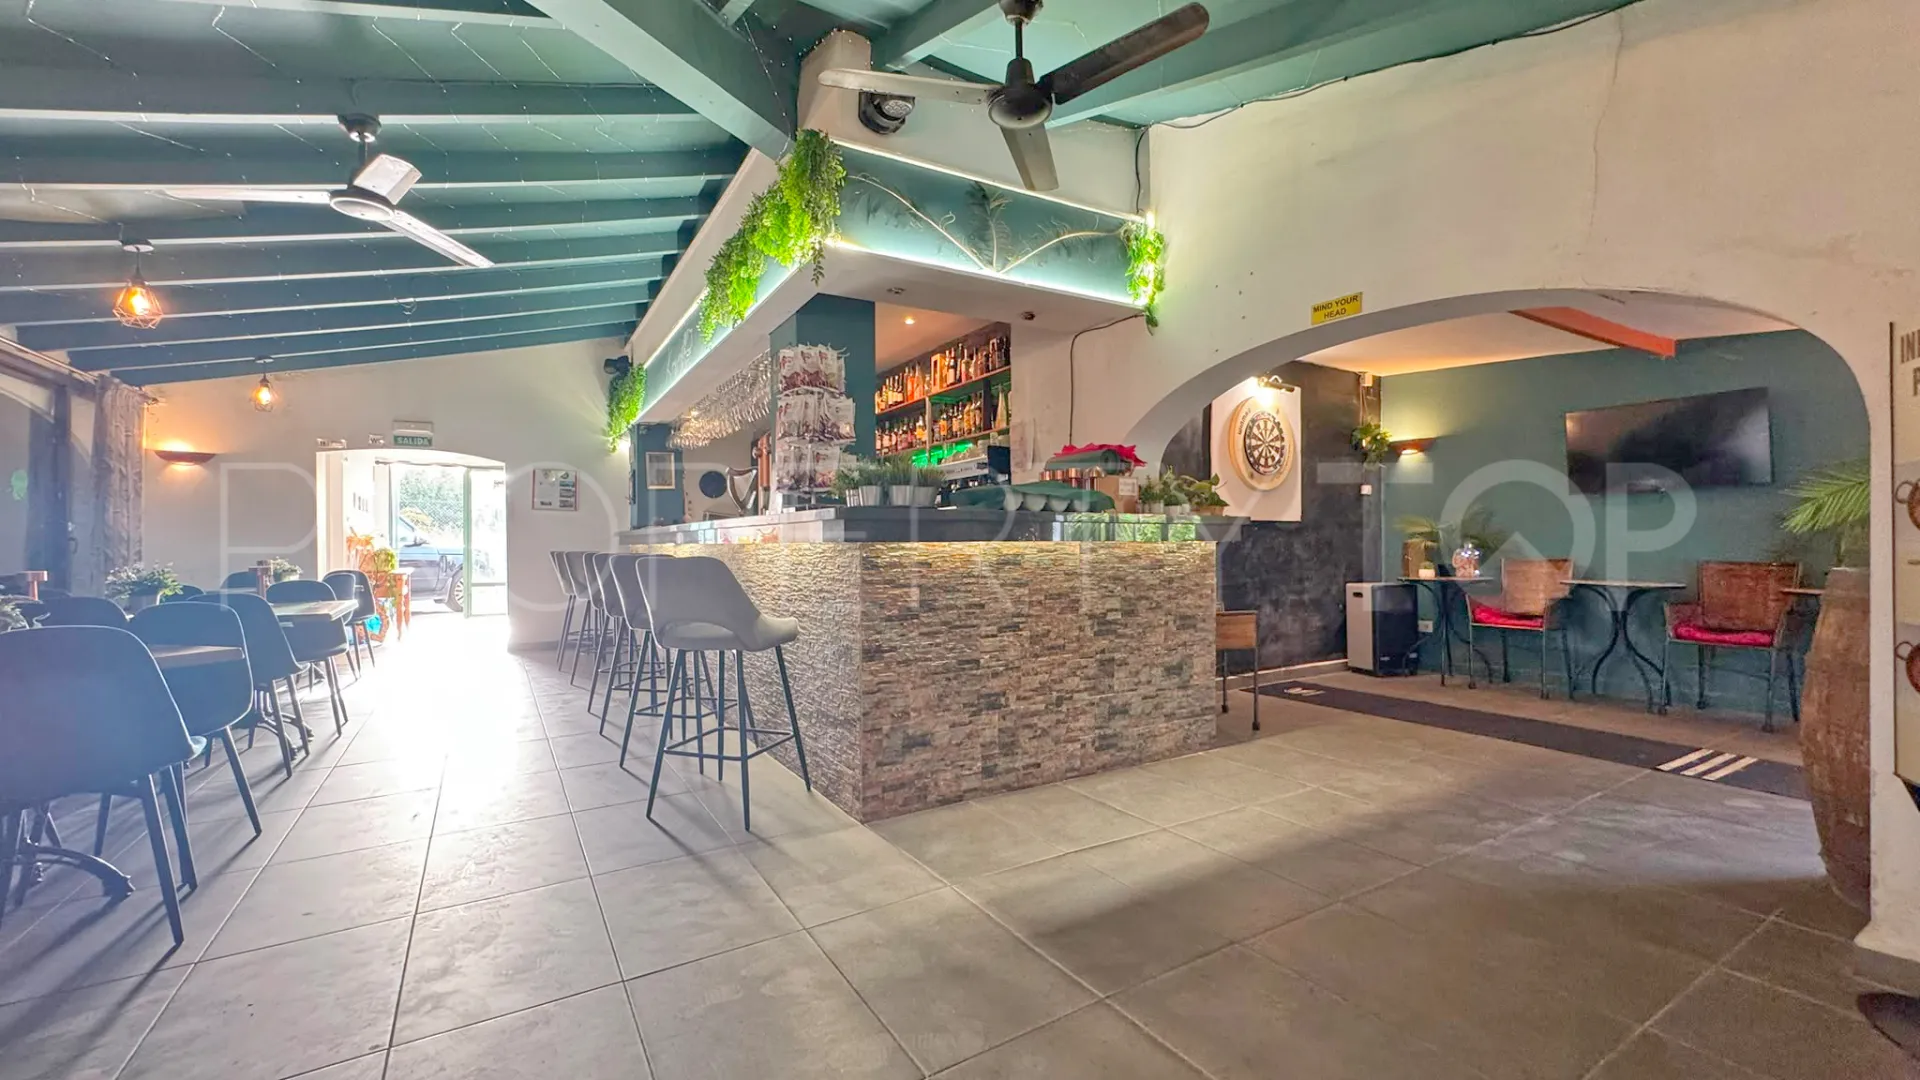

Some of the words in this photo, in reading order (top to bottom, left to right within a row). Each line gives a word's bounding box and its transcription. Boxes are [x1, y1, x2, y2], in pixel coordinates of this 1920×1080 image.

[1313, 302, 1333, 313] MIND
[1334, 294, 1359, 307] YOUR
[1323, 307, 1347, 319] HEAD
[1900, 329, 1920, 364] IN
[397, 436, 430, 446] SALIDA
